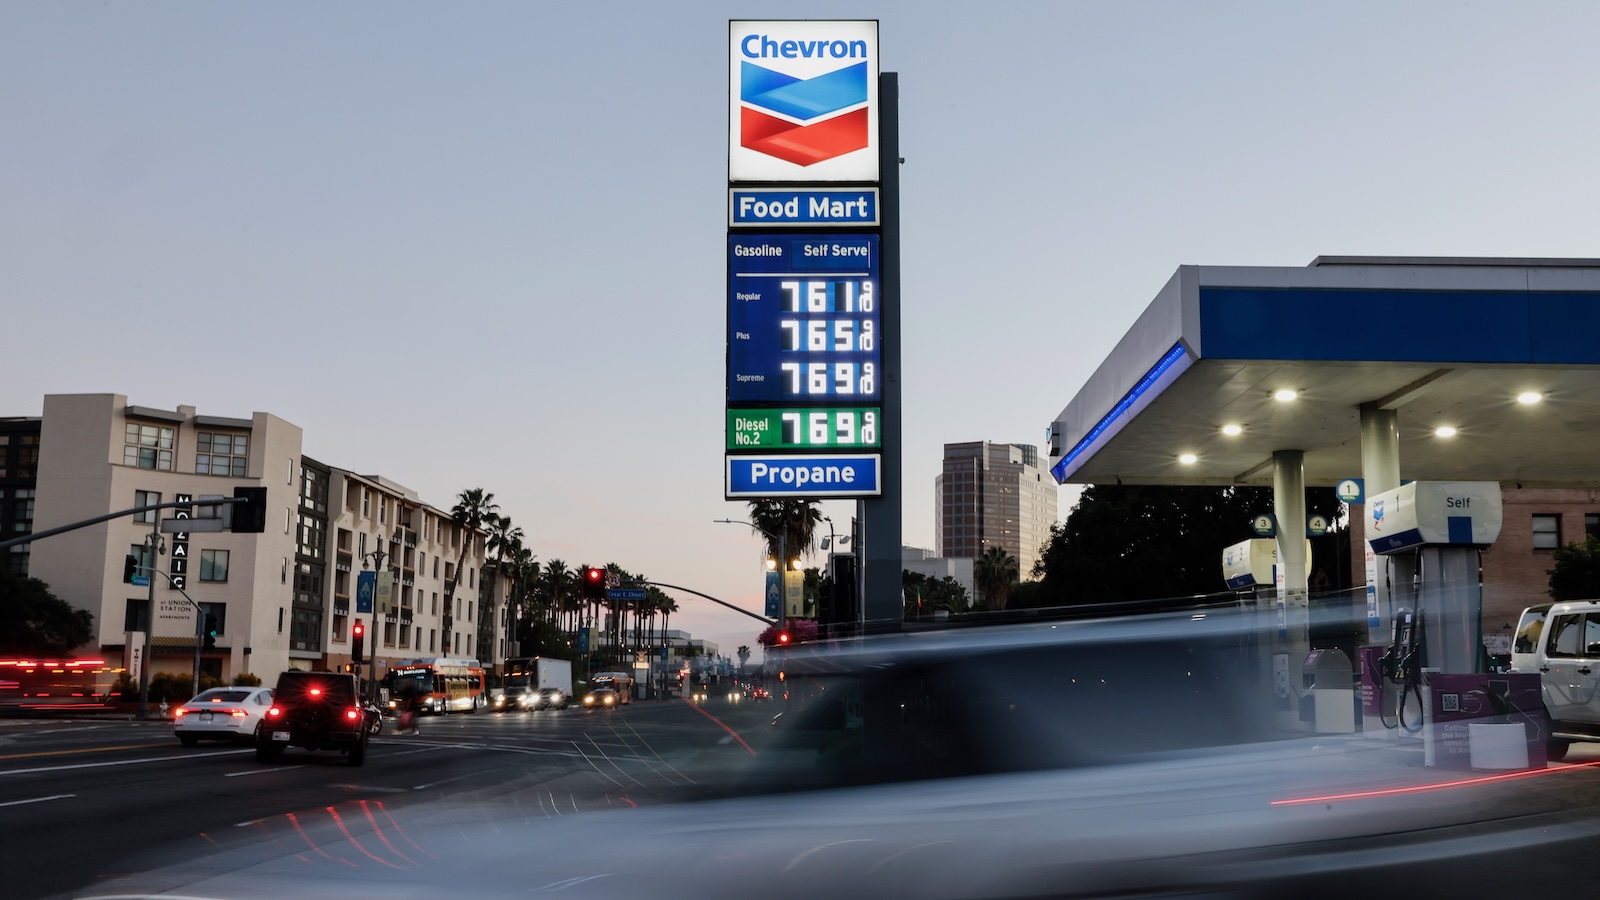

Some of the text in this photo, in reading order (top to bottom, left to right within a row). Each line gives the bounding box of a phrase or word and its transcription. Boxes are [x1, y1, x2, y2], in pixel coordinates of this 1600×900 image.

[741, 34, 867, 58] Chevron
[740, 196, 868, 218] Food Mart
[734, 244, 868, 257] Gasoline Self Serve
[736, 292, 761, 302] Regular
[781, 281, 853, 312] 761
[736, 332, 750, 340] Plus
[781, 320, 853, 351] 765
[736, 374, 765, 383] Supreme
[781, 363, 854, 394] 769
[735, 418, 768, 431] Diesel
[735, 432, 760, 445] No.2
[782, 412, 855, 444] 769
[751, 462, 855, 488] Propane
[1346, 484, 1351, 494] 1
[1446, 496, 1471, 508] Self
[1260, 519, 1267, 527] 3
[1314, 519, 1321, 527] 4
[1444, 724, 1469, 732] Califor
